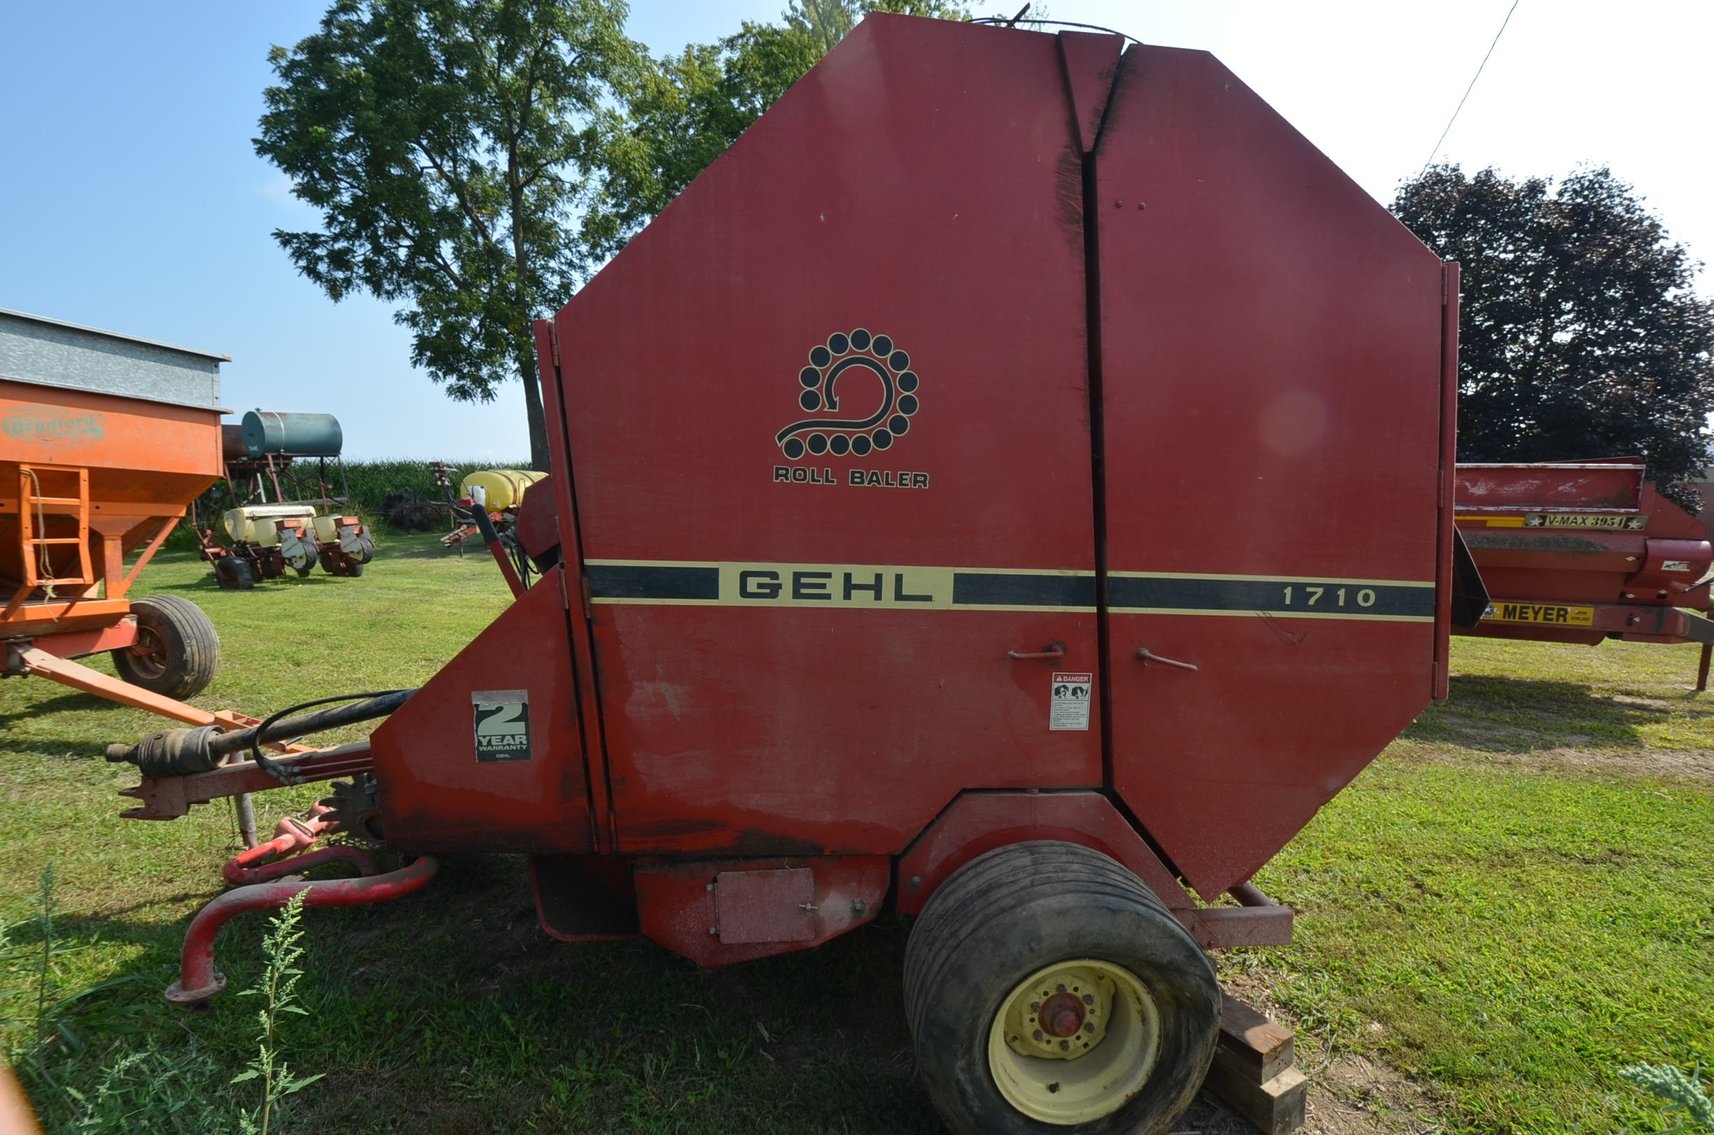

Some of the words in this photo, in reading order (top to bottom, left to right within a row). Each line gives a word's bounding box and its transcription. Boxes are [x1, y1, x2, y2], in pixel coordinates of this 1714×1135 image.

[773, 466, 836, 485] ROLL
[849, 470, 929, 488] BALER
[1548, 515, 1588, 527] V-MAX
[739, 570, 933, 602] GEHL
[1283, 586, 1376, 607] 1710
[1502, 604, 1568, 622] MEYER
[478, 703, 525, 735] 2
[478, 735, 527, 745] YEAR
